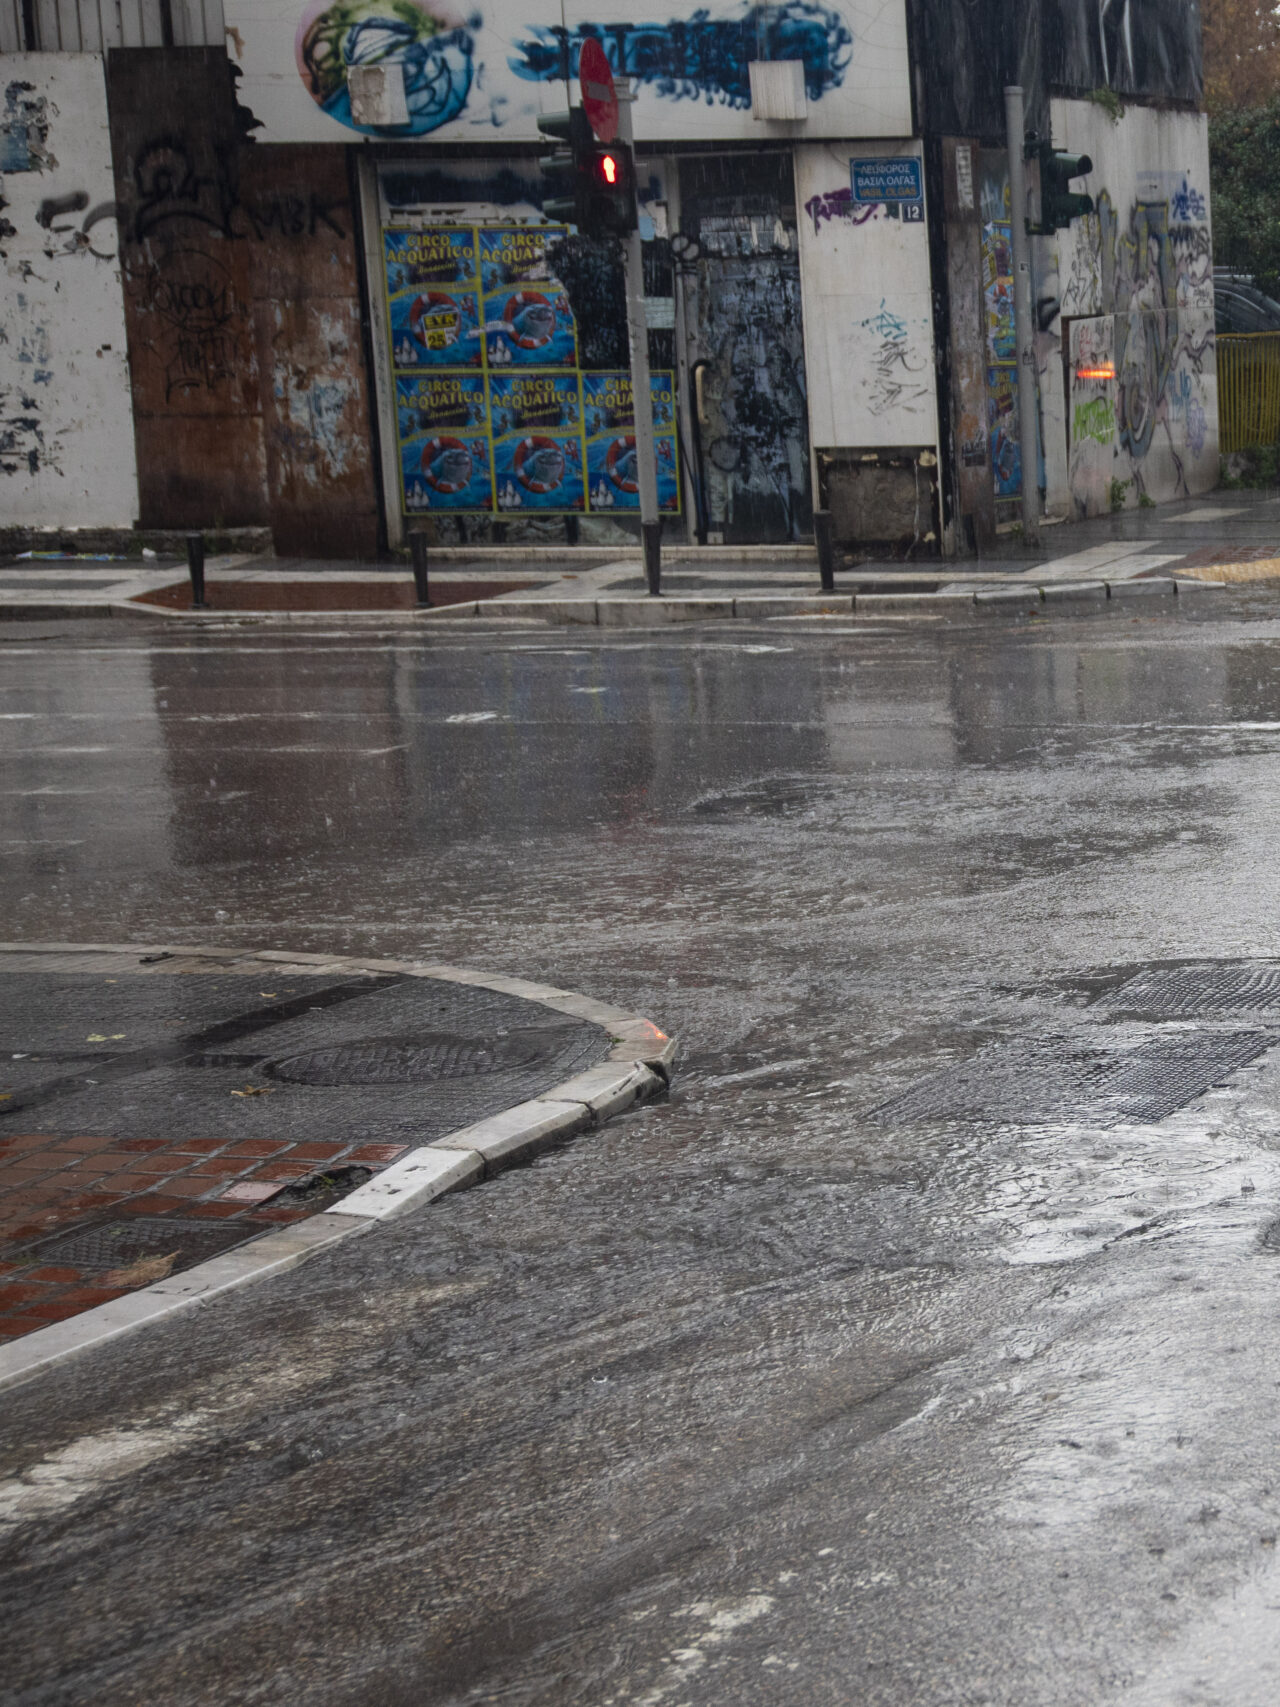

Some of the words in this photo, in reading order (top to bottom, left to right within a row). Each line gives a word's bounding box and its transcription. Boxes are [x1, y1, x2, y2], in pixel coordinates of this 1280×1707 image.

[886, 175, 915, 185] ΟΛΓΑΣ
[906, 205, 920, 219] 12
[407, 234, 451, 247] CIRCO
[502, 233, 545, 247] CIRCO
[387, 247, 474, 265] ACQUATICO
[481, 247, 539, 265] ACQUA
[418, 380, 461, 393] CIRCO
[511, 380, 555, 392] CIRCO
[398, 391, 484, 409] ACQUATICO
[491, 391, 577, 409] ACQUATICO
[585, 390, 671, 409] ACQUACO
